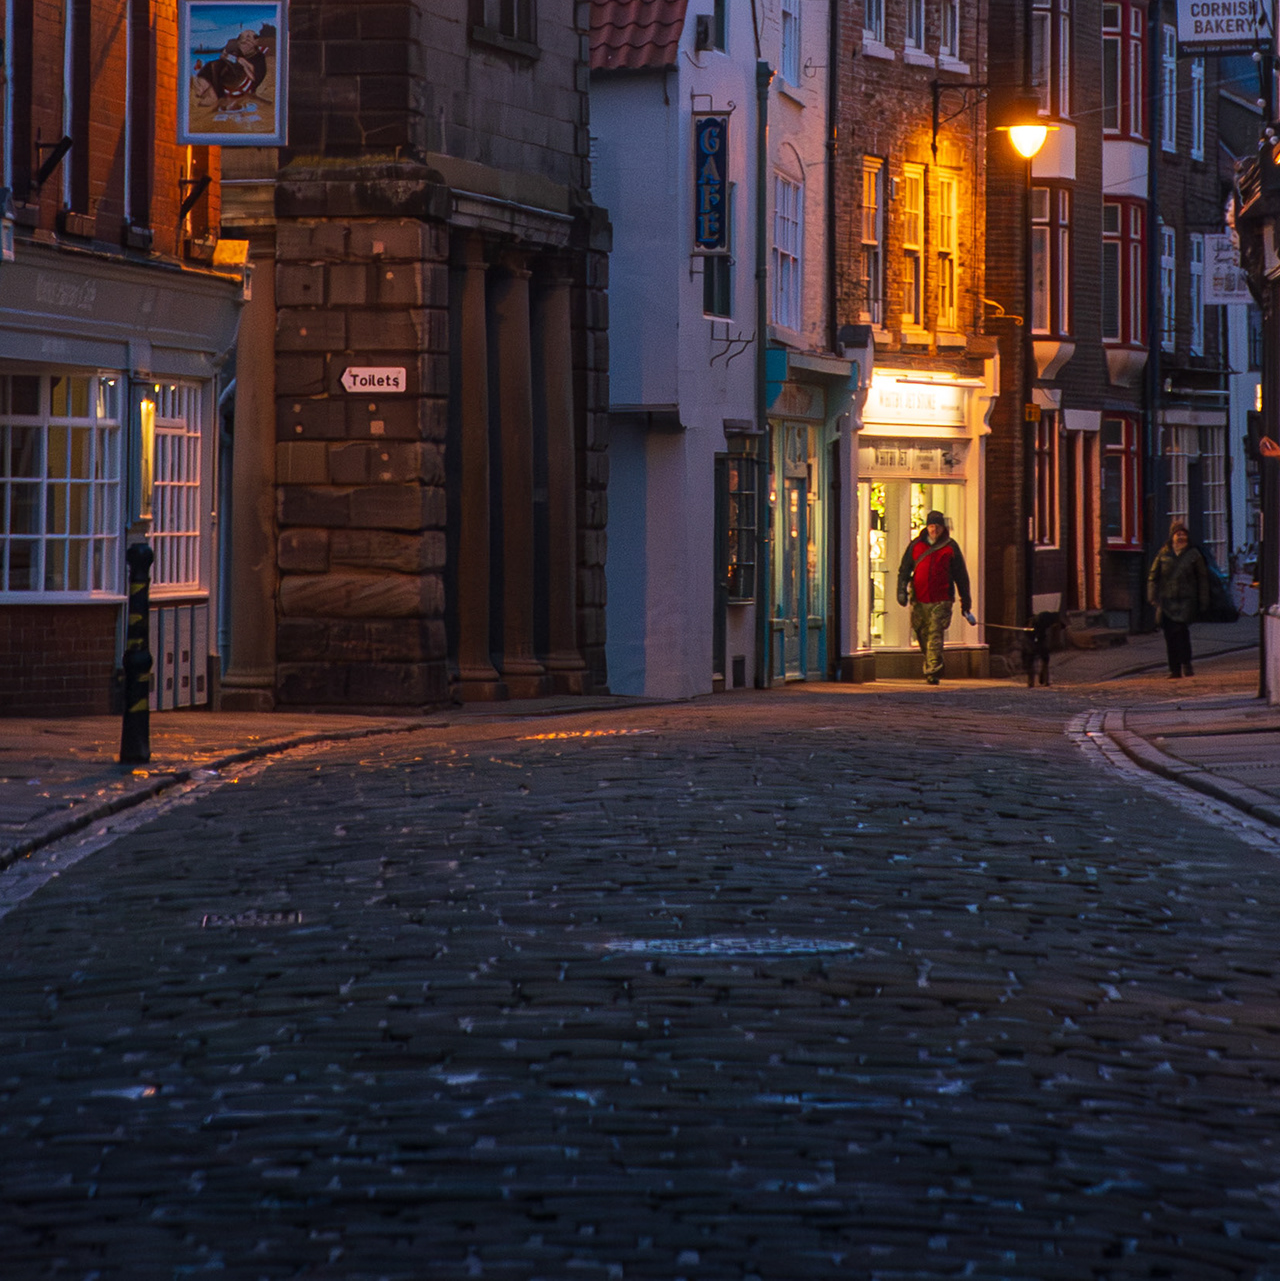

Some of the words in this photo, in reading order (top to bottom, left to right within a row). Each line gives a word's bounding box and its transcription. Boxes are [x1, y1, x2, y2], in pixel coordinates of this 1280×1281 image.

[1190, 1, 1258, 18] CORNISH
[1194, 18, 1256, 35] BAKERY
[350, 374, 400, 387] Toilets
